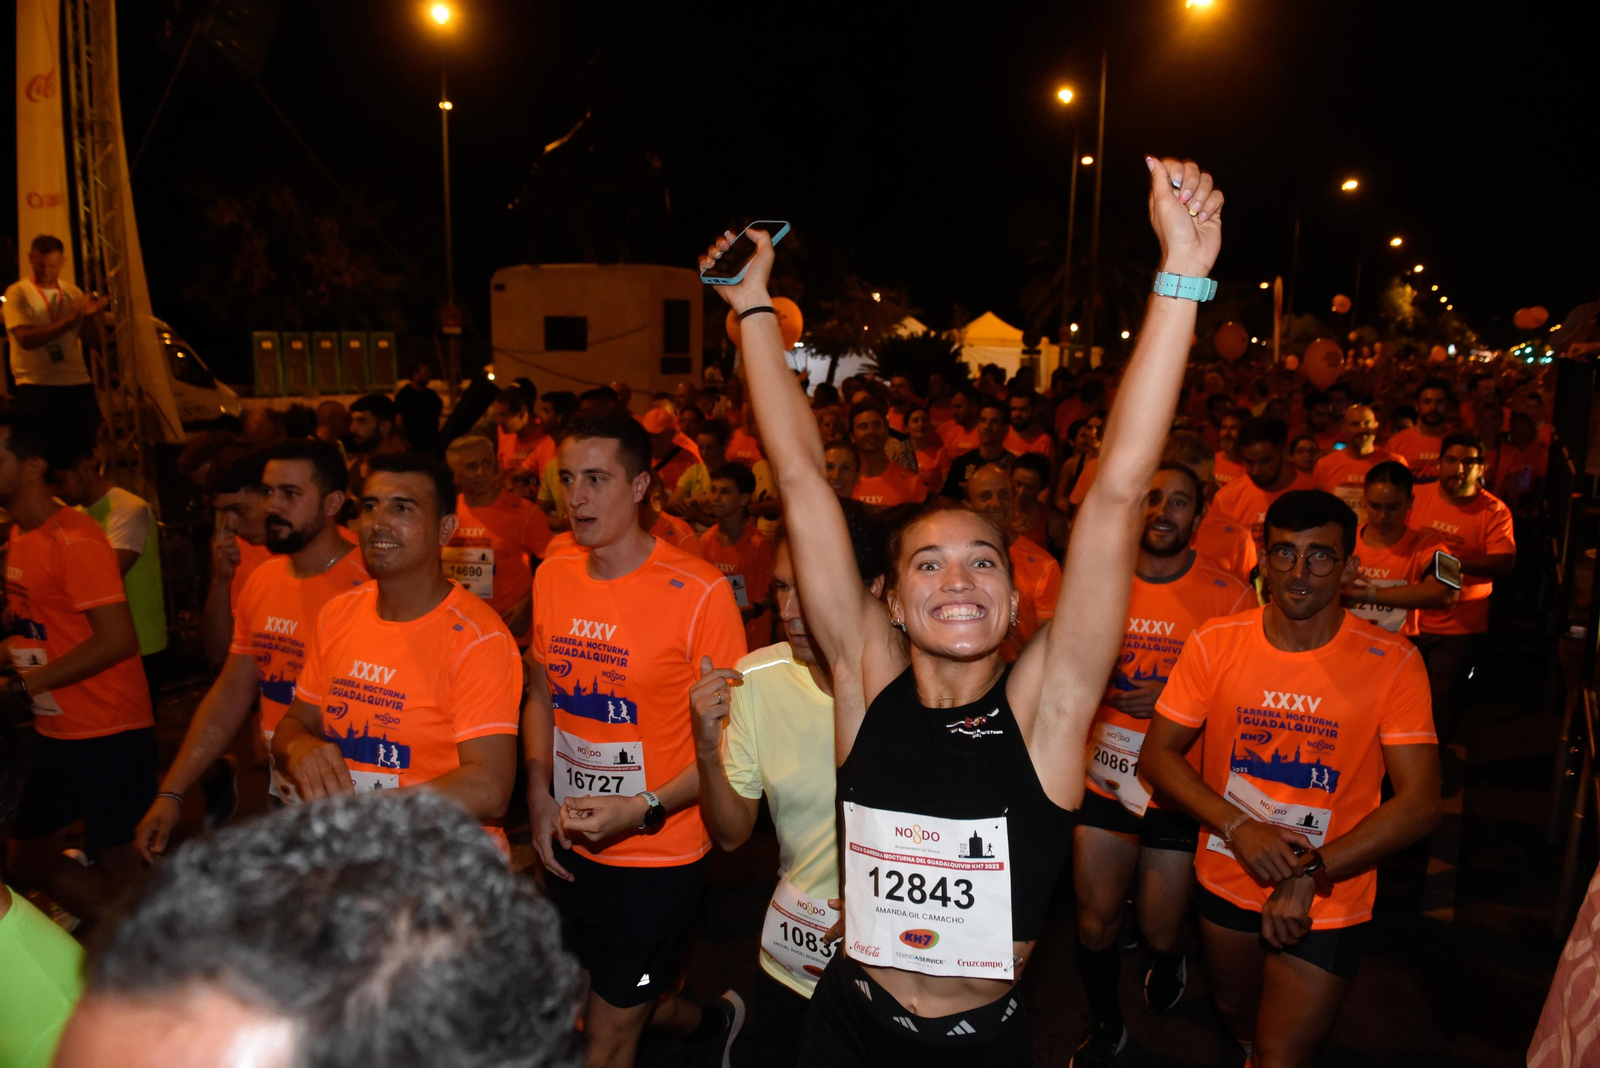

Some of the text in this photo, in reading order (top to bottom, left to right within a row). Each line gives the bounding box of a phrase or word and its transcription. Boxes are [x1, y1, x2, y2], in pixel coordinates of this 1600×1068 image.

[459, 527, 486, 537] XXXV
[1431, 519, 1461, 535] XXXV
[450, 565, 483, 577] 14690
[264, 615, 299, 636] XXXV
[568, 617, 618, 642] XXXV
[1127, 617, 1177, 637] XXXV
[551, 635, 583, 648] CARRERA
[586, 641, 630, 657] NOCTURNA
[1146, 635, 1185, 647] NOCTURN
[552, 644, 629, 668] GUADALQUIVIR
[348, 659, 398, 686] XXXV
[331, 676, 361, 690] CARRERA
[362, 683, 407, 701] NOCTURNA
[332, 686, 405, 712] GUADALQUIVIR
[1260, 689, 1323, 715] XXXV
[1236, 706, 1340, 729] CARRERA NOCTURNA
[1242, 716, 1339, 740] GUADALQUIVIR
[1093, 746, 1139, 777] 20861
[566, 767, 625, 794] 16727
[863, 848, 884, 858] CARRERA
[883, 853, 916, 863] NOCTURNA
[926, 859, 971, 870] GUADALQUIVIR
[868, 865, 976, 910] 12843
[875, 906, 965, 925] AMANDA GIL CAMACHO
[779, 920, 841, 959] 1083
[957, 958, 1004, 969] Cruzcampo
